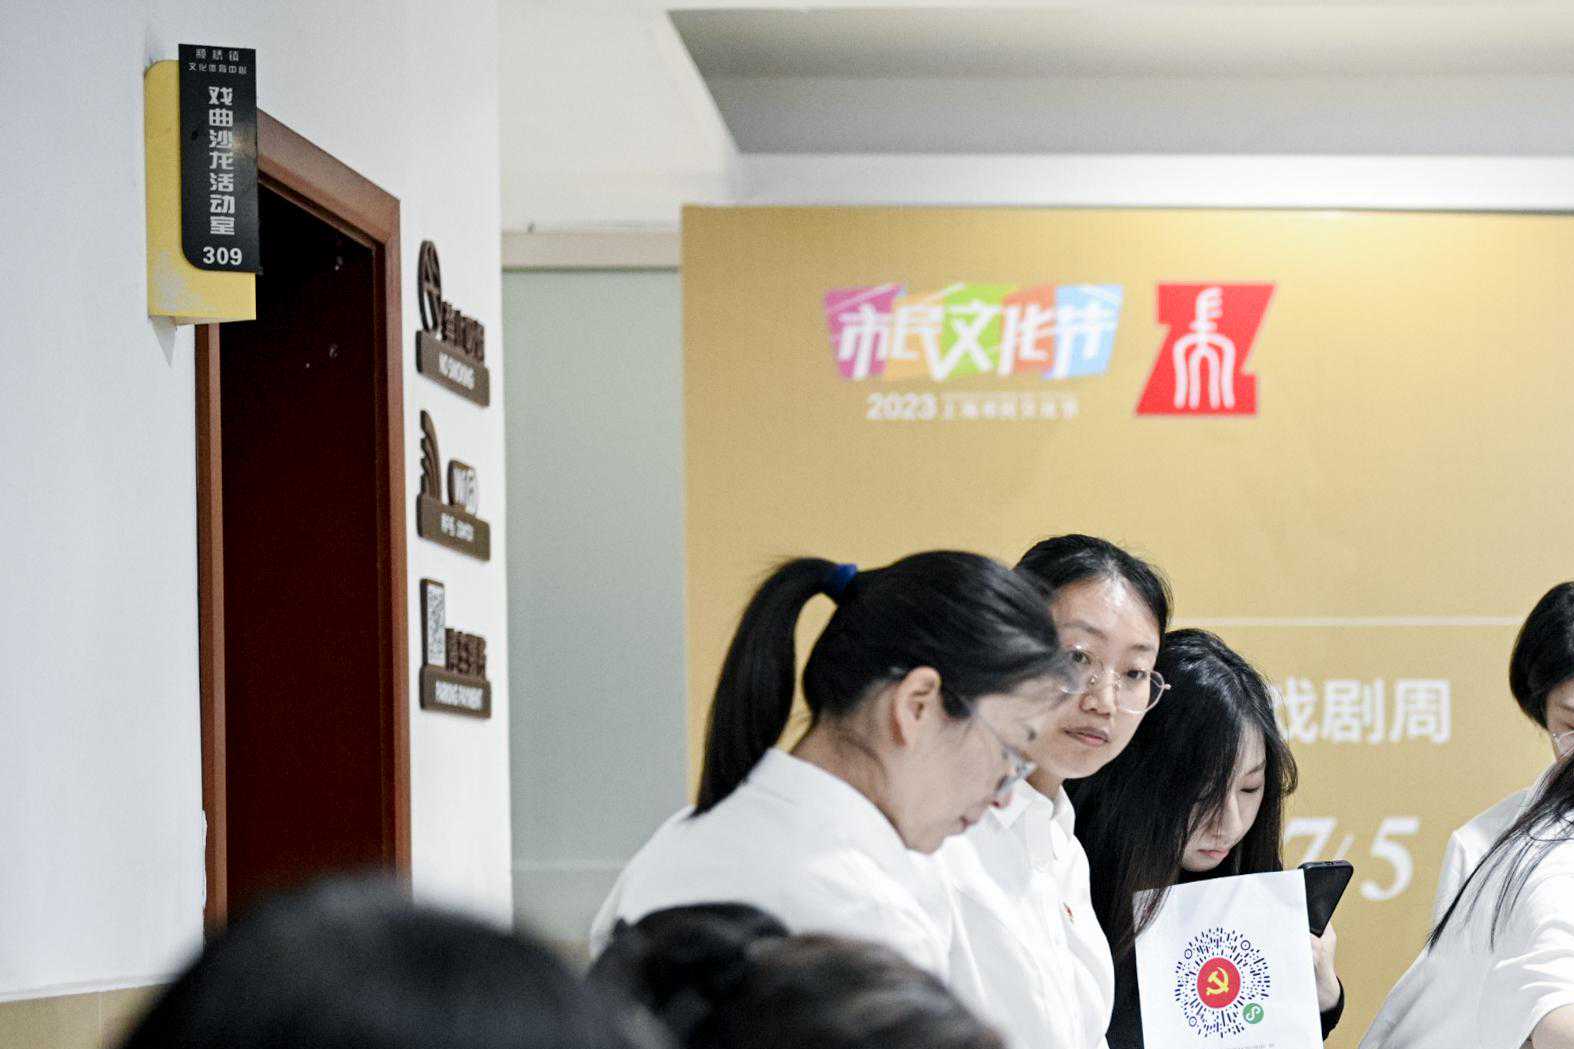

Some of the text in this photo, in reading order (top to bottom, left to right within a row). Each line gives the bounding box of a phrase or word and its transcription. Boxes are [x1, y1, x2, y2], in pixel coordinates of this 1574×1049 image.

[208, 85, 236, 236] 戏曲沙龙活动室
[202, 246, 243, 265] 309
[836, 296, 1118, 382] 市民文化节
[866, 391, 938, 420] 2023
